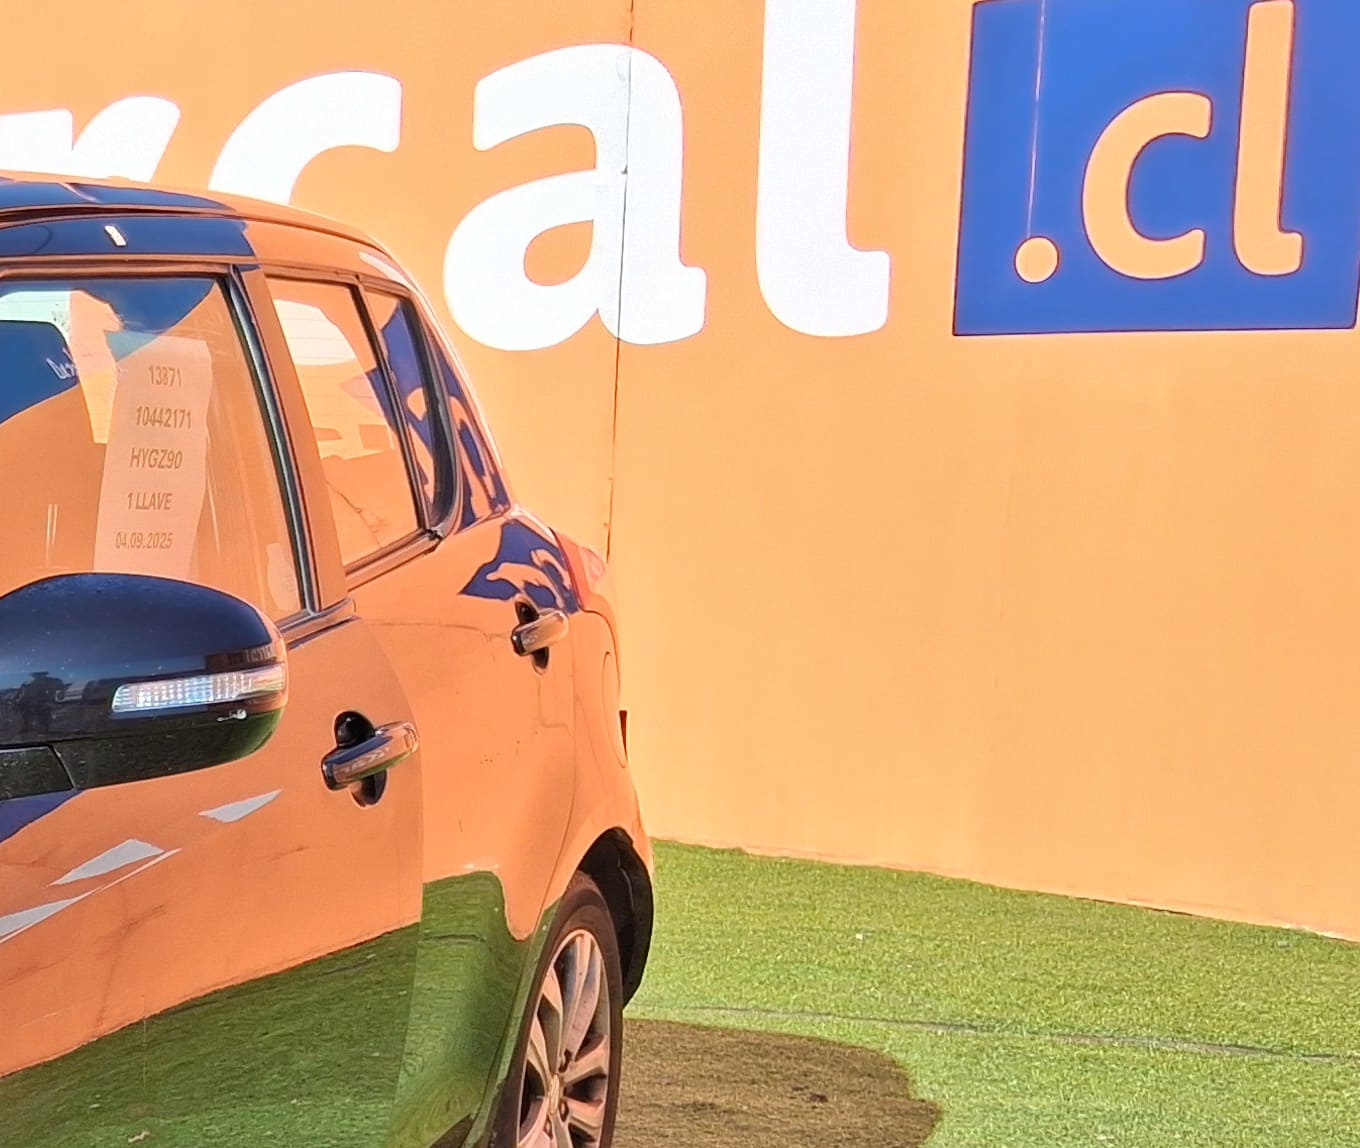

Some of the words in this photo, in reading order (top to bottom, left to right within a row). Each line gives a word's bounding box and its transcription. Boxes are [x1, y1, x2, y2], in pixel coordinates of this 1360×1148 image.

[1014, 0, 1303, 284] .cl
[136, 406, 192, 430] 10442171
[130, 447, 183, 470] HYGZ90
[135, 492, 173, 511] LLAVE
[115, 531, 174, 550] 04.09.2025
